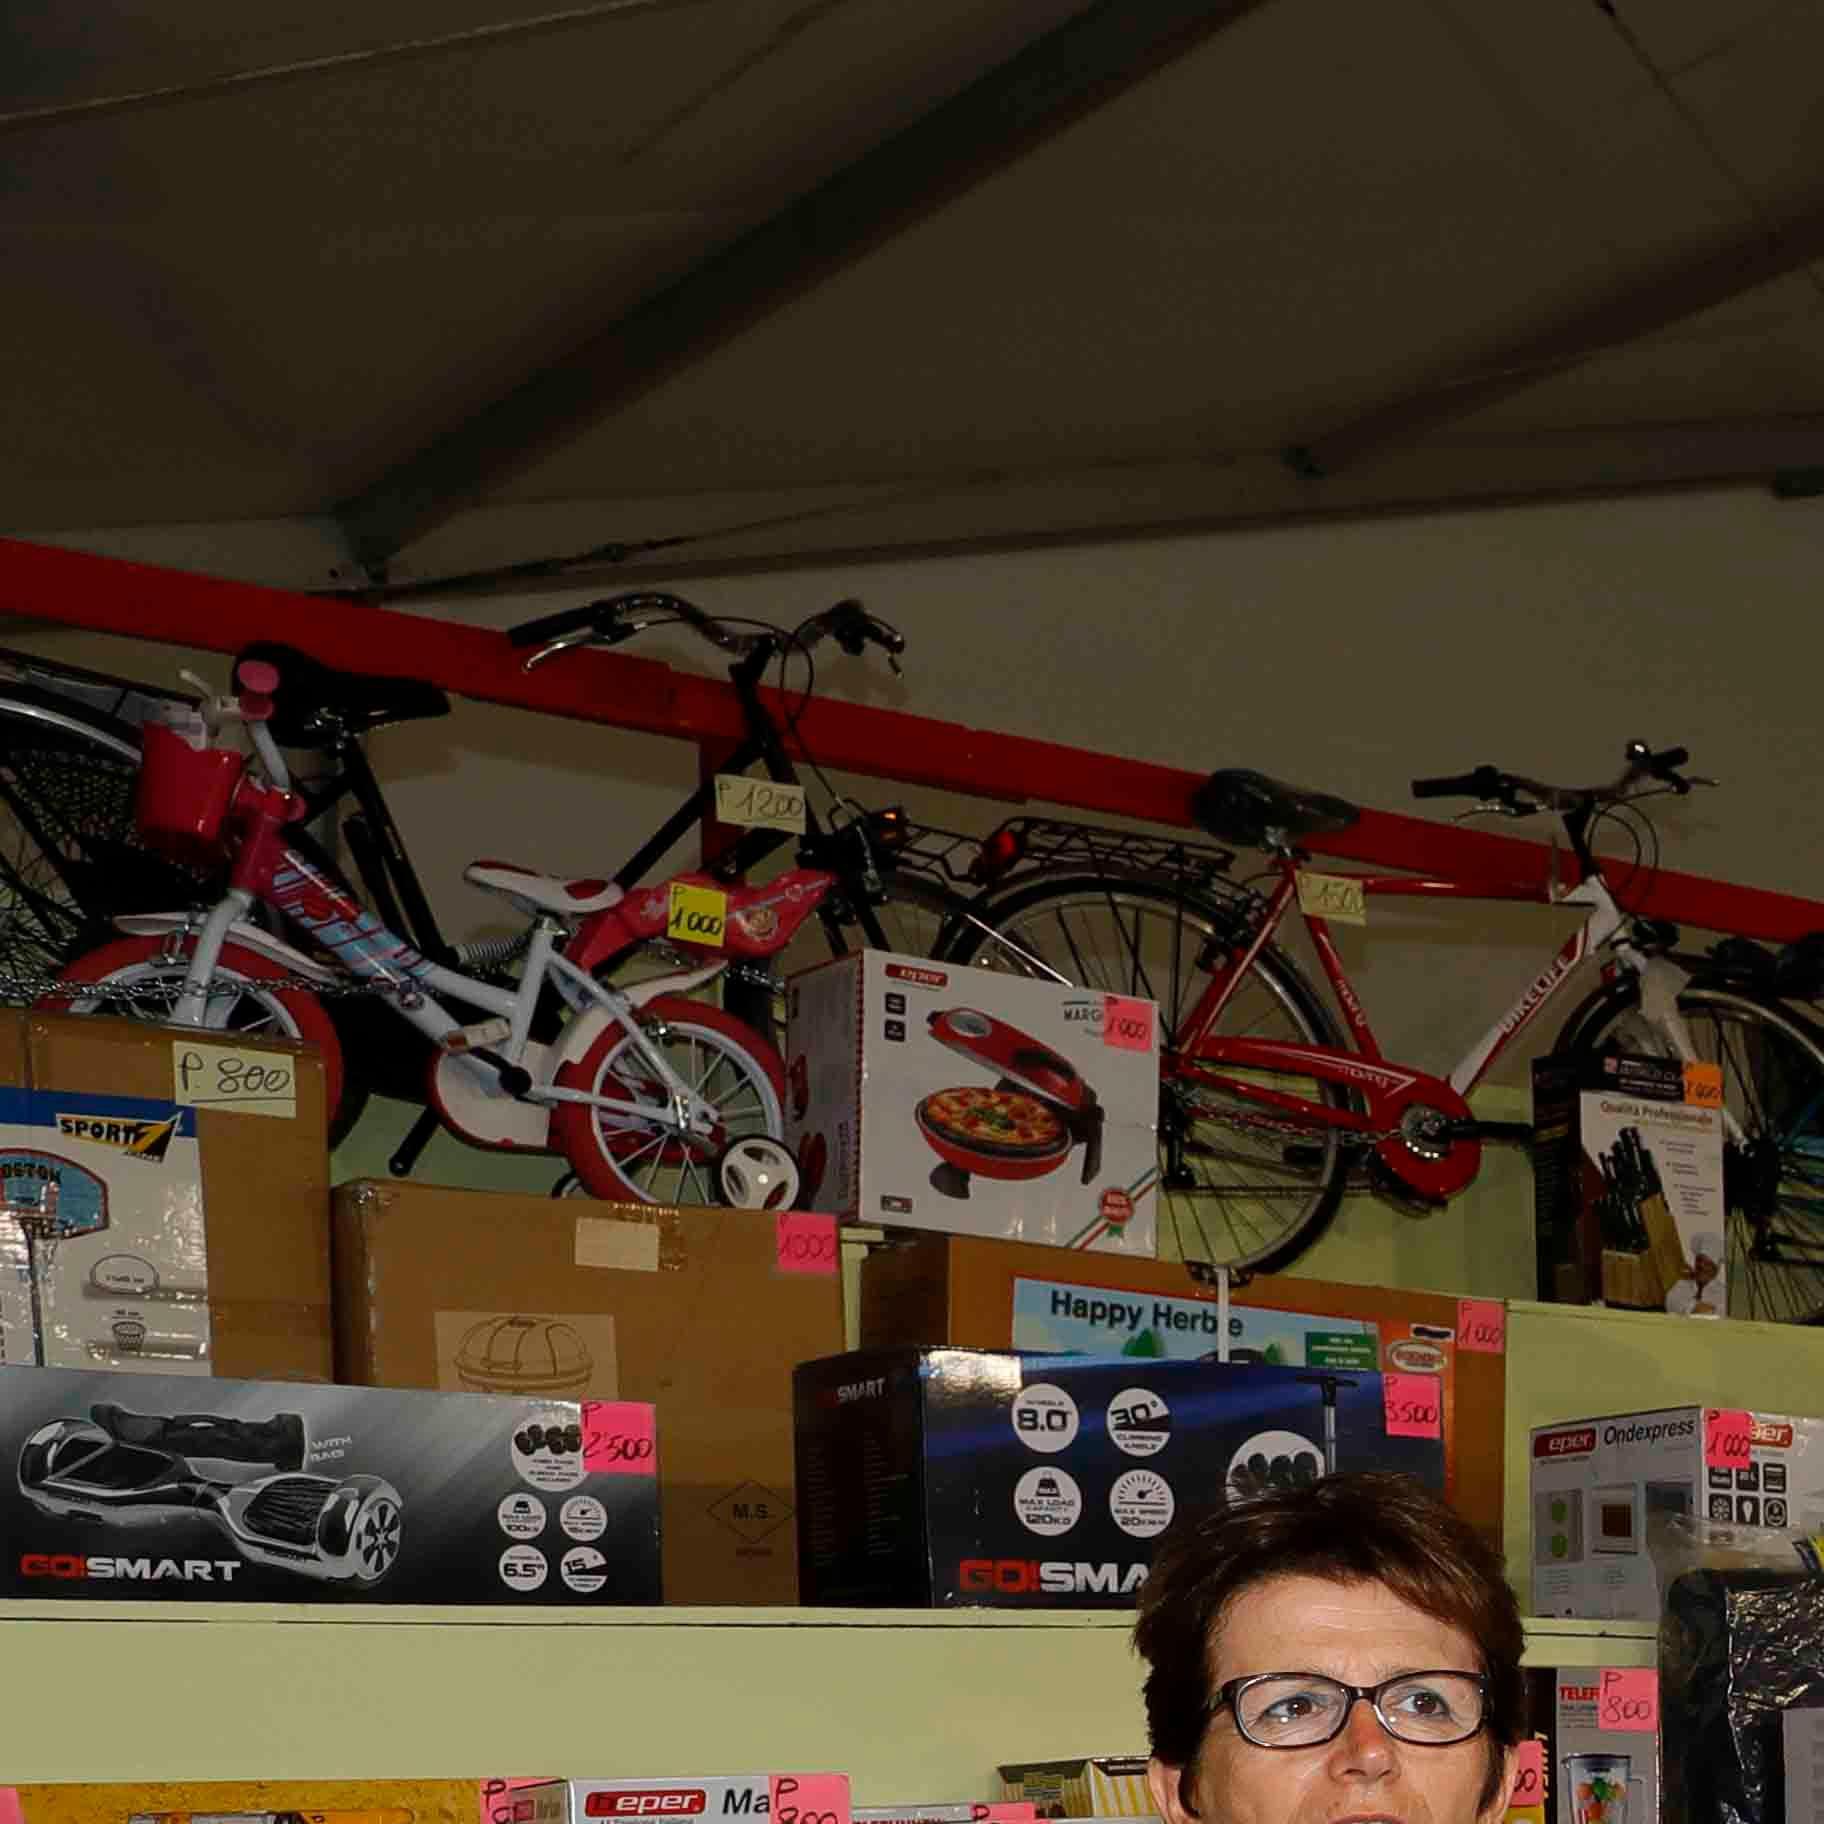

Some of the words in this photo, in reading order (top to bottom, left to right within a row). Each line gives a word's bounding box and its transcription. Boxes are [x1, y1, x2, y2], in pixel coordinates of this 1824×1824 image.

[217, 1057, 290, 1093] 800
[1051, 1290, 1142, 1331] Happy
[1153, 1300, 1244, 1337] Herbe
[1603, 1420, 1696, 1447] Ondexpress
[1605, 1671, 1623, 1695] P
[1602, 1696, 1650, 1722] 800
[776, 1778, 799, 1808] P
